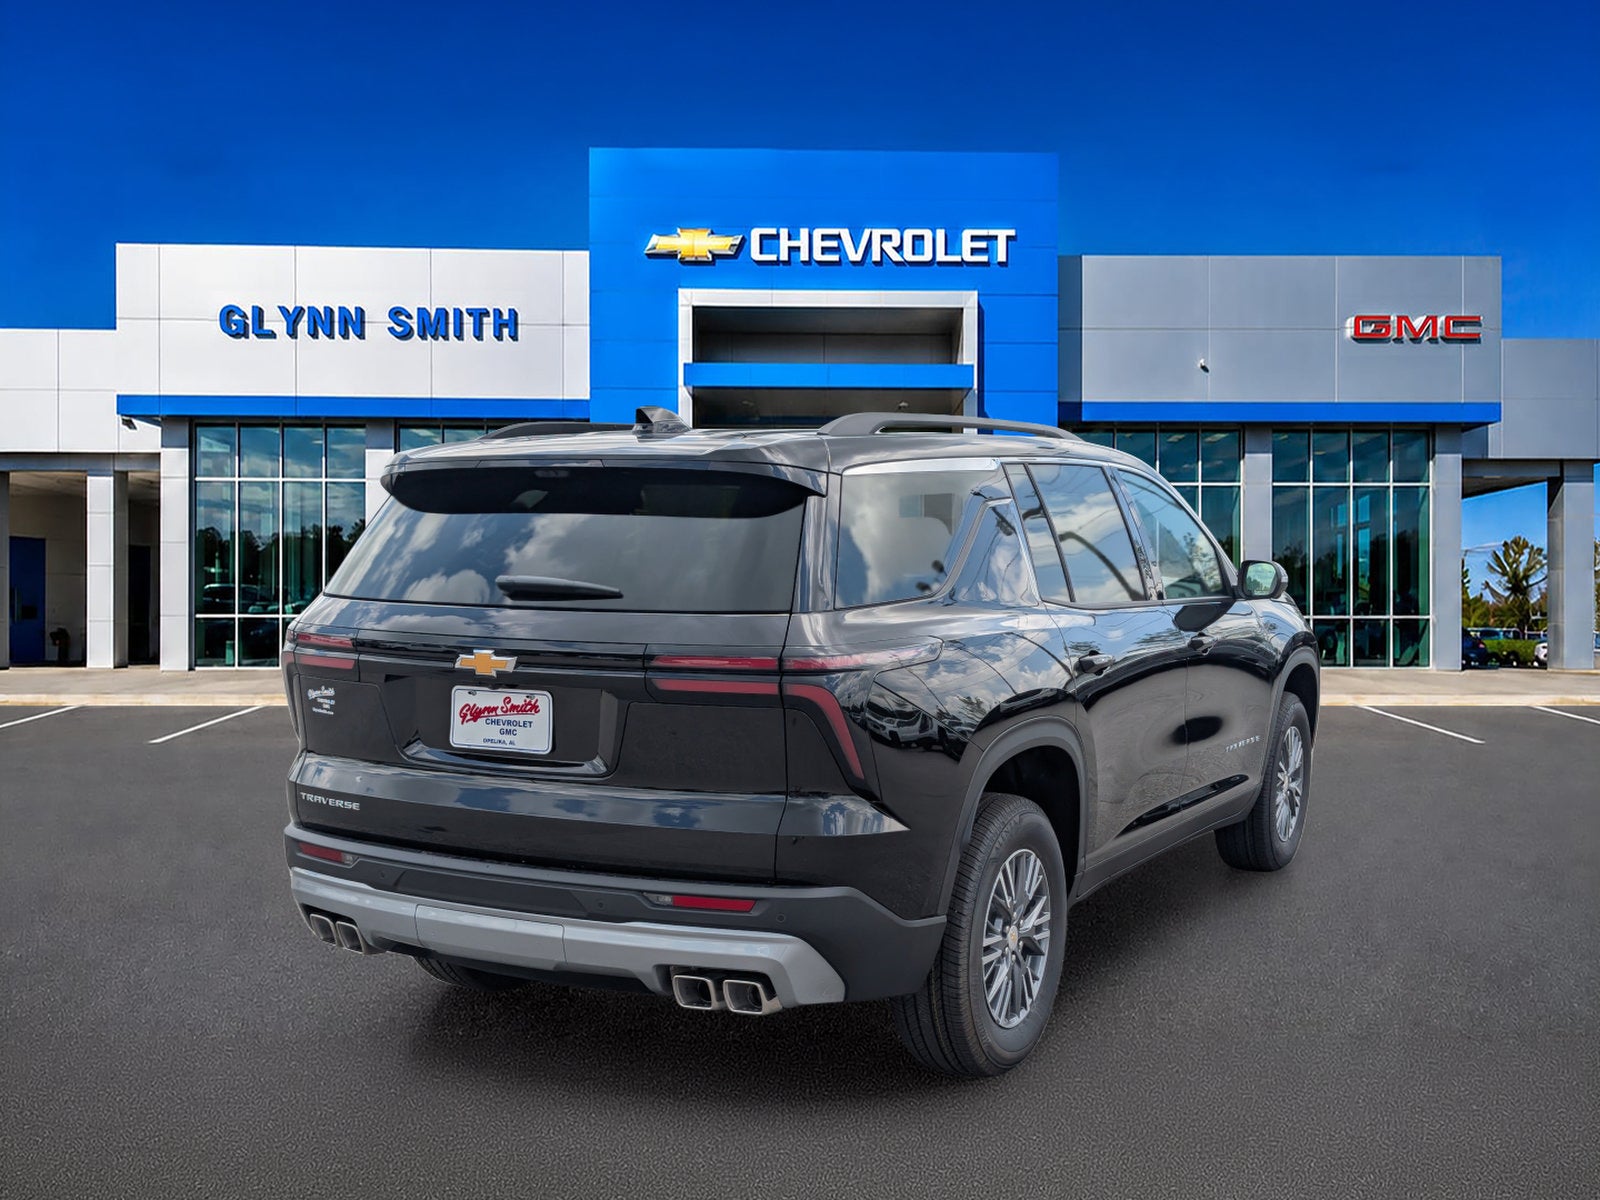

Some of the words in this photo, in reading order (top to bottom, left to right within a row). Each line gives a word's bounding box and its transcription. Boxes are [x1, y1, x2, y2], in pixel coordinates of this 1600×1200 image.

[750, 227, 1016, 264] CHEVROLET
[218, 304, 365, 339] GLYNN
[387, 306, 519, 341] SMITH
[1350, 314, 1483, 341] GMC
[459, 703, 499, 725] Glynn
[500, 696, 541, 714] Smith
[484, 717, 534, 728] CHEVROLET
[499, 728, 517, 736] GMC
[300, 791, 361, 811] TRAVERSE
